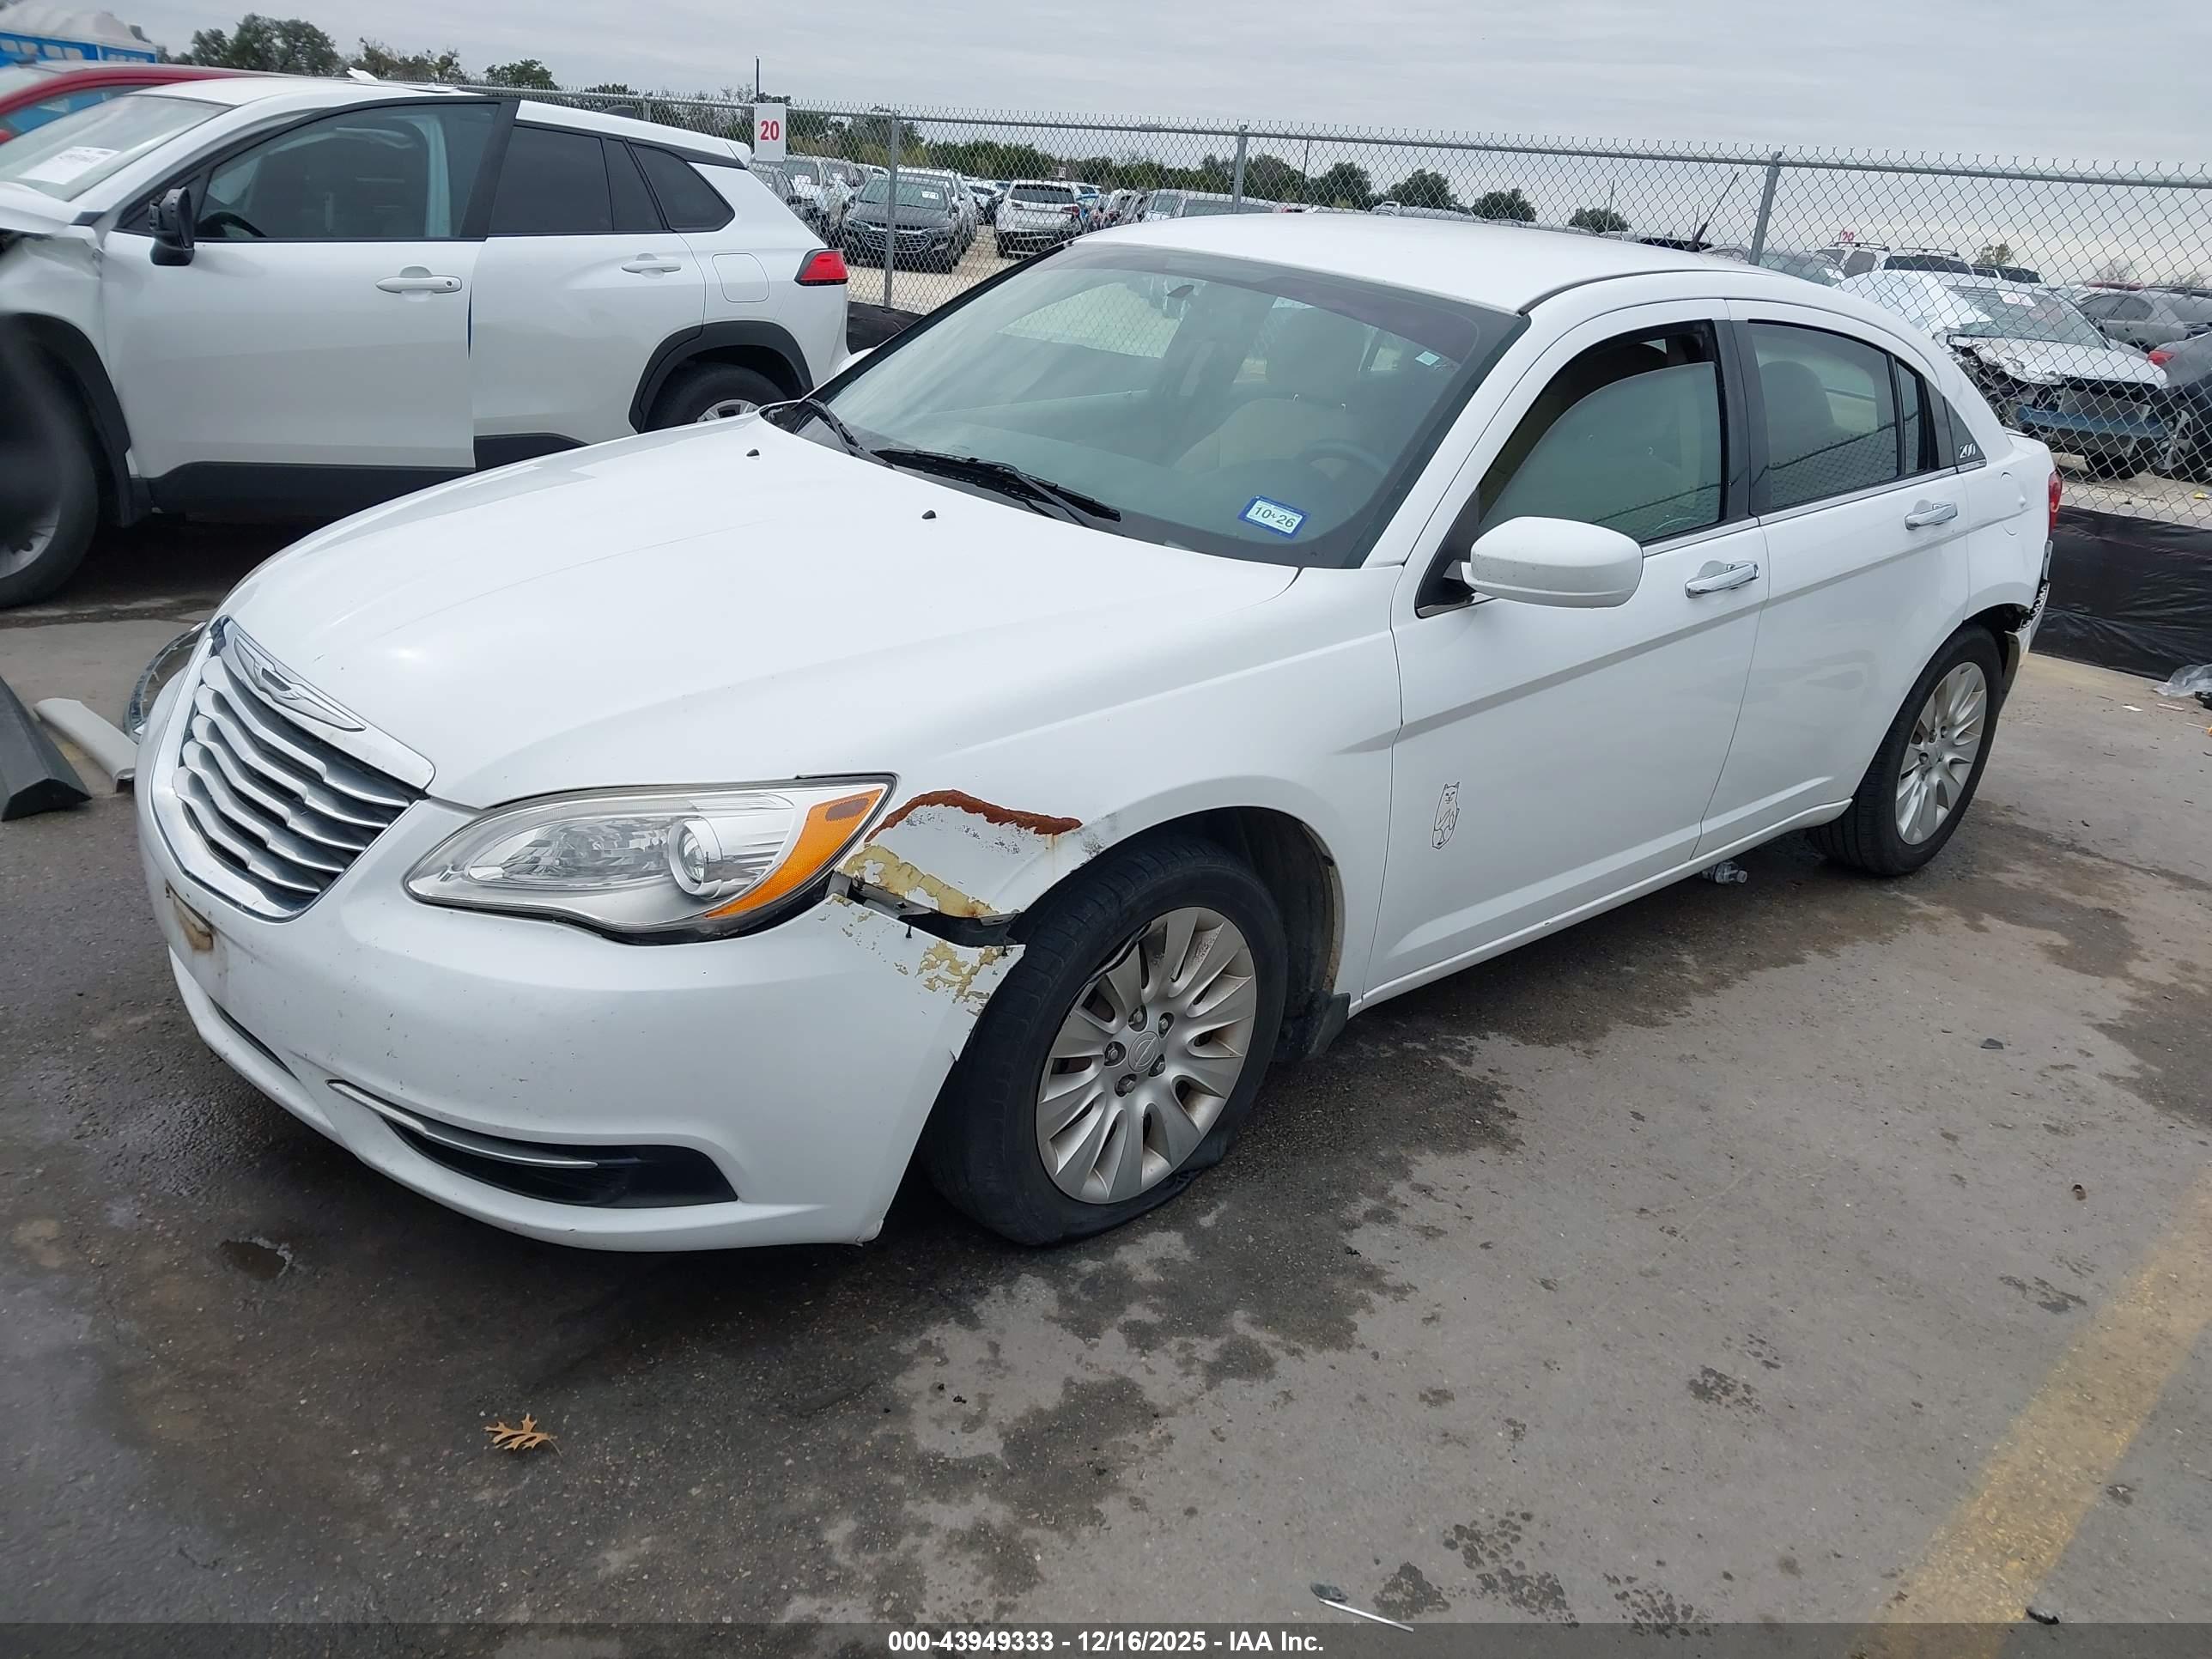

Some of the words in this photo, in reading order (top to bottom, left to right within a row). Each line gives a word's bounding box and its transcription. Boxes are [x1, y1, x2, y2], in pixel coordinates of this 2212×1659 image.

[760, 120, 780, 141] 20
[1255, 507, 1272, 519] 10
[1276, 514, 1296, 528] 26
